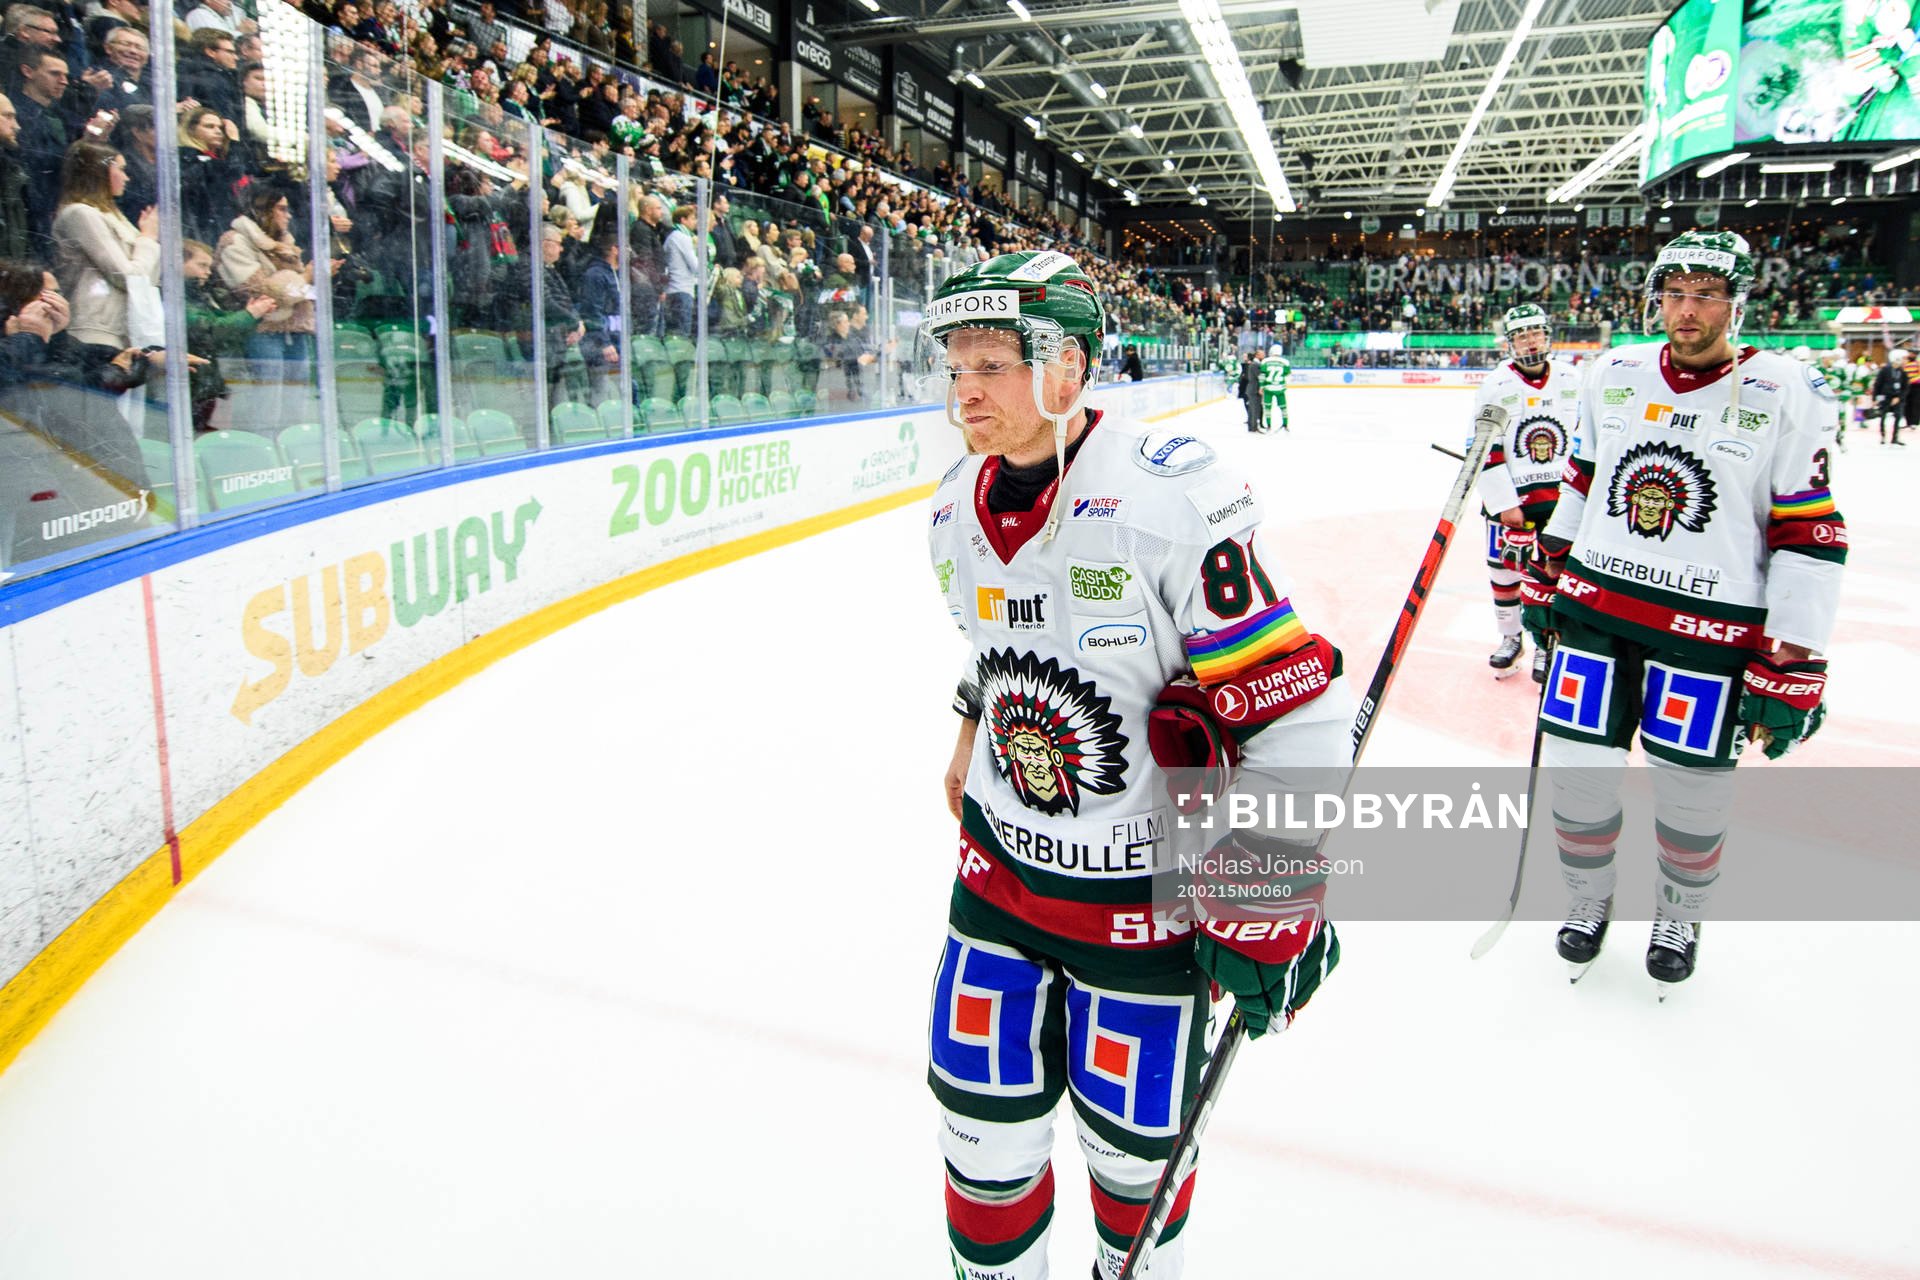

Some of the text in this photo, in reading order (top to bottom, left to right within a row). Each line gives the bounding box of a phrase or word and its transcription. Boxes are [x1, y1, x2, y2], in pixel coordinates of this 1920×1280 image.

[797, 41, 831, 70] areco
[1488, 216, 1536, 226] CATENA
[1539, 215, 1577, 225] Arena
[1666, 250, 1731, 264] BJURFORS
[717, 440, 791, 479] METER
[1716, 444, 1747, 458] BOHUS
[222, 466, 293, 493] UNISPORT
[718, 464, 801, 508] HOCKEY
[609, 452, 711, 538] 200
[1090, 498, 1119, 509] INTER
[42, 498, 139, 540] UNISPORT
[1001, 517, 1018, 527] SHL
[1088, 507, 1116, 518] SPORT
[1207, 502, 1238, 526] KUMHO
[1071, 568, 1107, 586] CASH
[1556, 573, 1598, 597] KF
[1584, 549, 1719, 597] SILVERBULLET
[1685, 564, 1721, 581] FILM
[1073, 582, 1122, 600] BUDDY
[230, 495, 543, 726] SUBWAY
[1670, 613, 1748, 643] SKF
[1088, 634, 1138, 648] BOHUS
[1247, 656, 1323, 695] TURKISH
[1254, 671, 1328, 711] AIRLINES
[1112, 814, 1165, 845] FILM
[1110, 904, 1191, 944] SK
[1106, 1248, 1125, 1263] SAN
